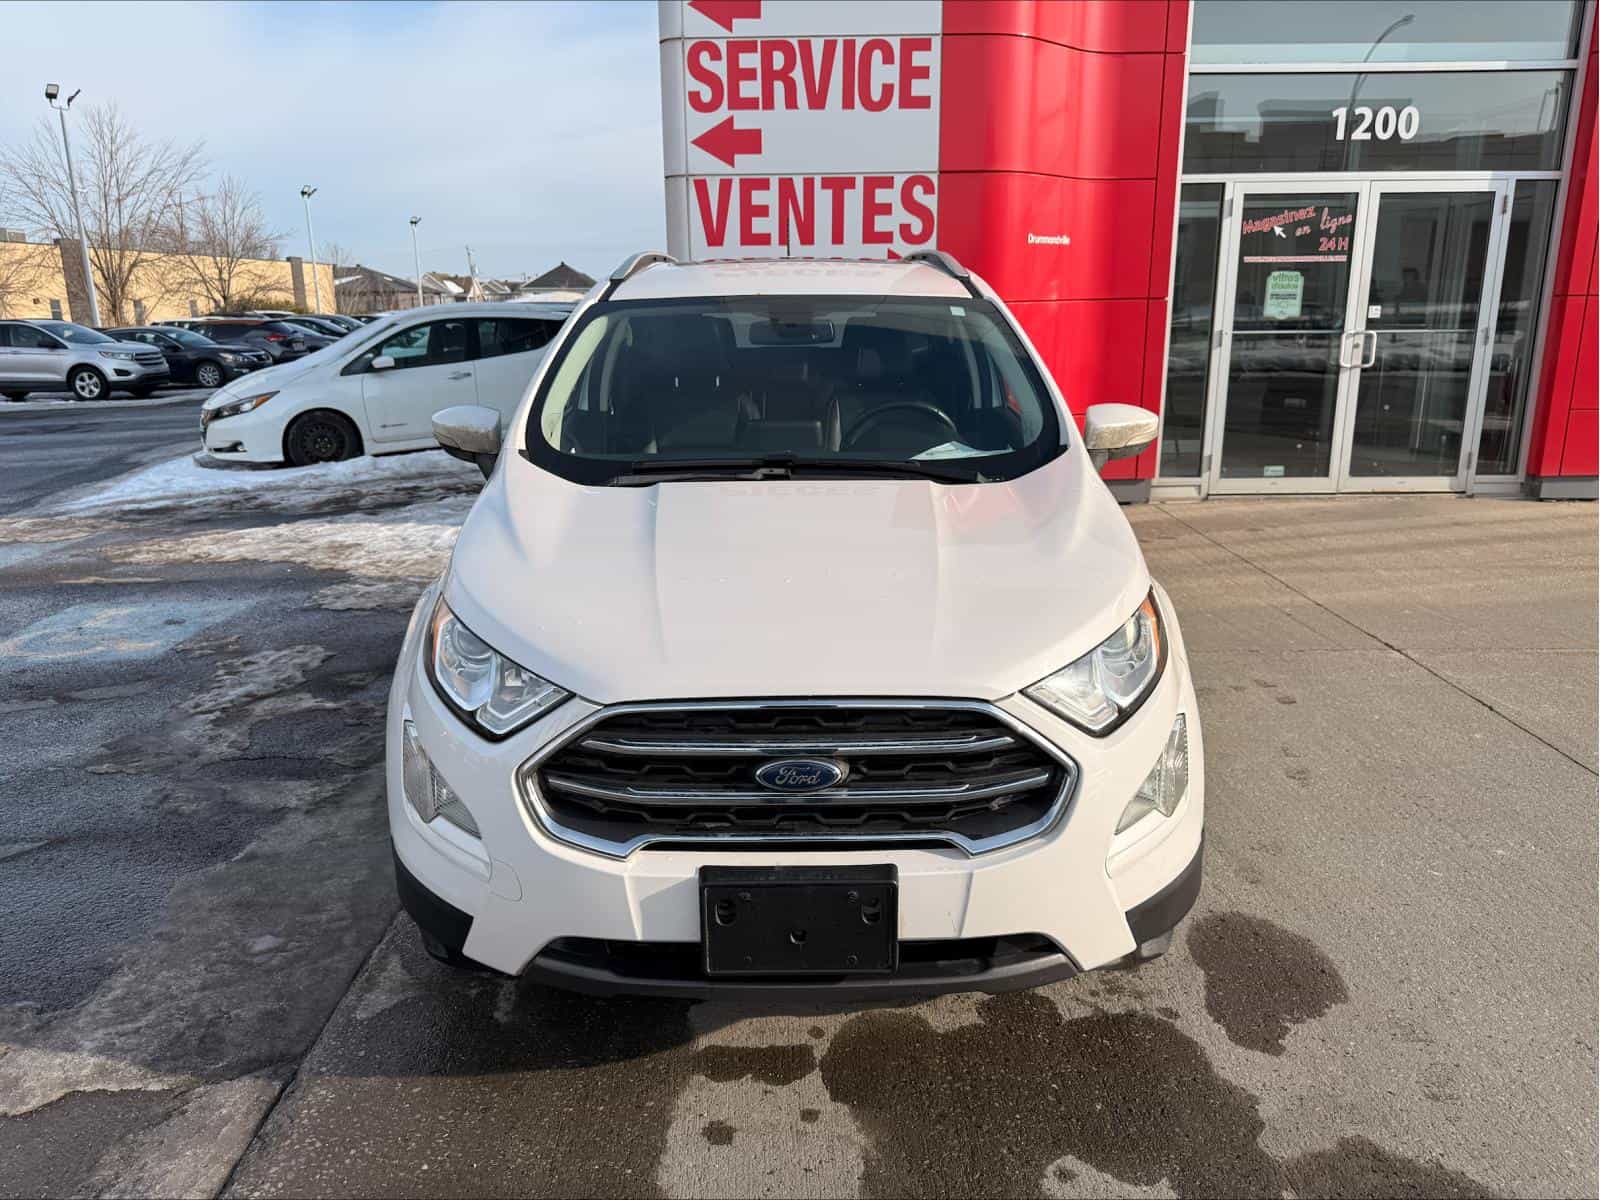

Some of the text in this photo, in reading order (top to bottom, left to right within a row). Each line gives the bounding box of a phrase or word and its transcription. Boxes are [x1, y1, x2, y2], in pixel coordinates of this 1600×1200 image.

[687, 37, 933, 114] SERVICE
[1332, 105, 1420, 141] 1200
[693, 173, 936, 248] VENTES
[1295, 225, 1312, 237] en
[1319, 207, 1353, 234] ligne
[775, 766, 822, 785] Ford
